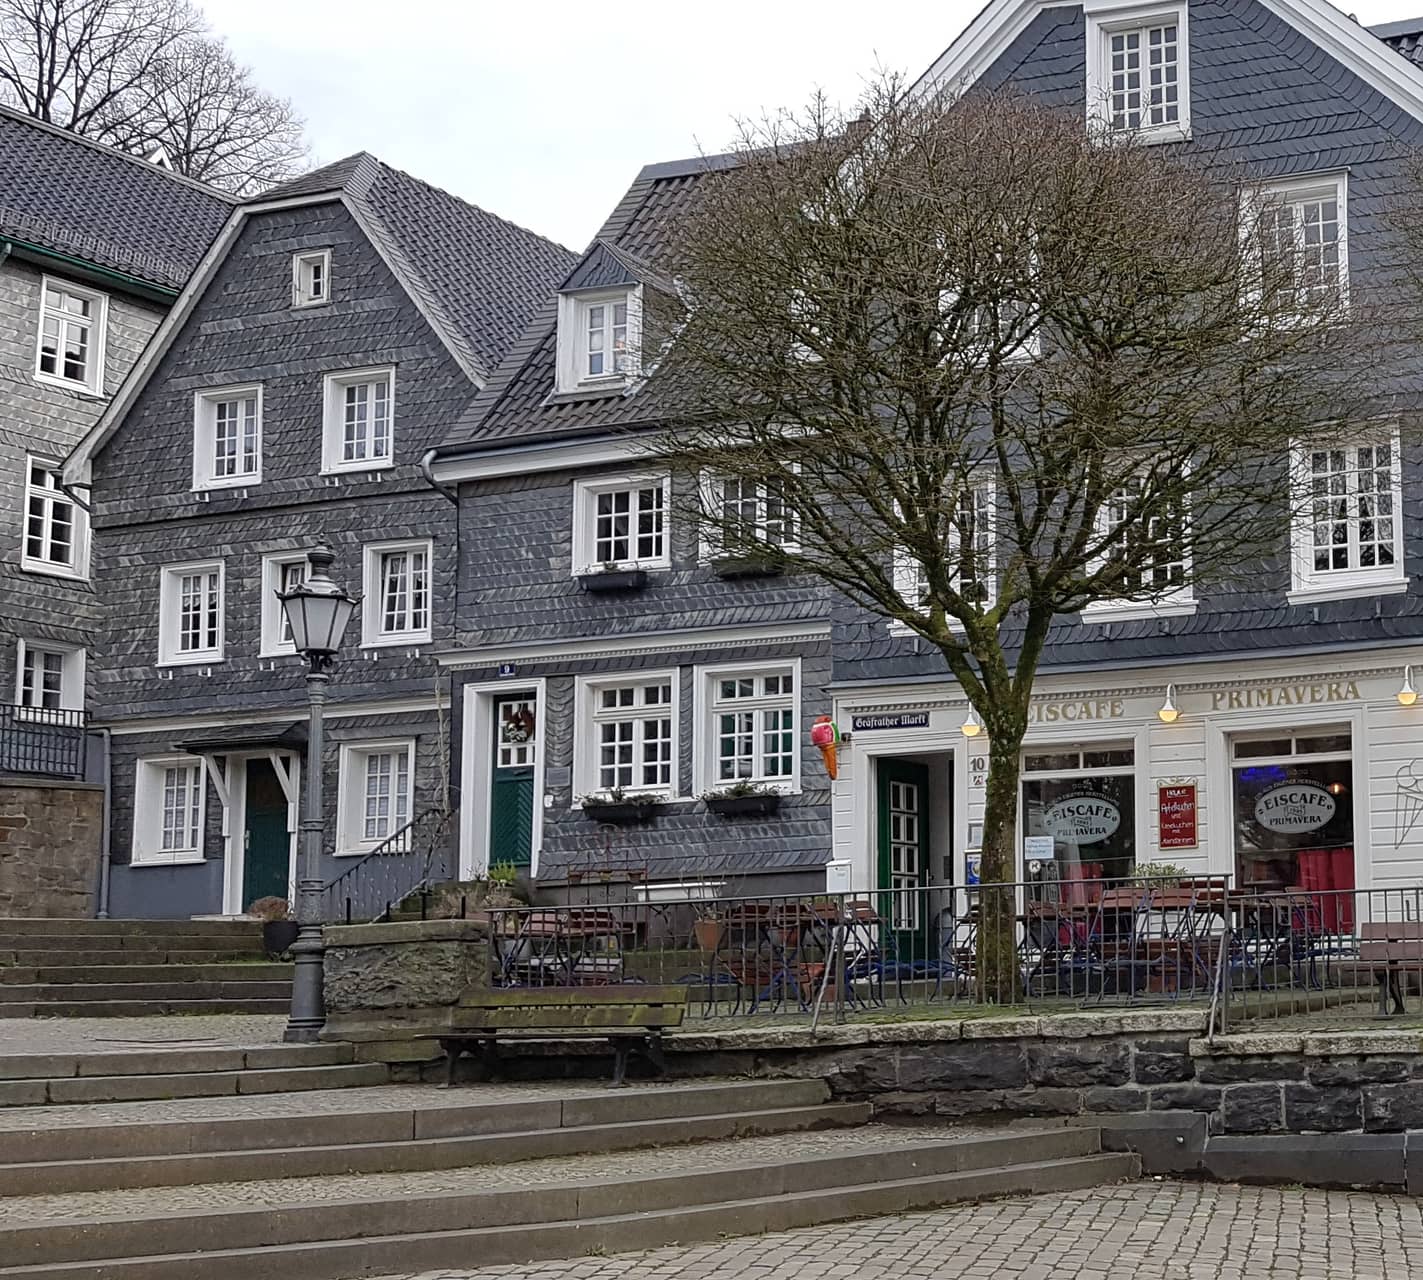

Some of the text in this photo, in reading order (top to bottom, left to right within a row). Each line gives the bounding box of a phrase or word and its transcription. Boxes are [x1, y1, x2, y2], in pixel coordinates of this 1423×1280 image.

[1211, 681, 1361, 711] PRIMAVERA
[856, 714, 926, 729] Gräfrather Markt
[970, 758, 985, 771] 10
[1263, 793, 1327, 811] EISCAFE
[1270, 815, 1321, 826] PRIMAVERA
